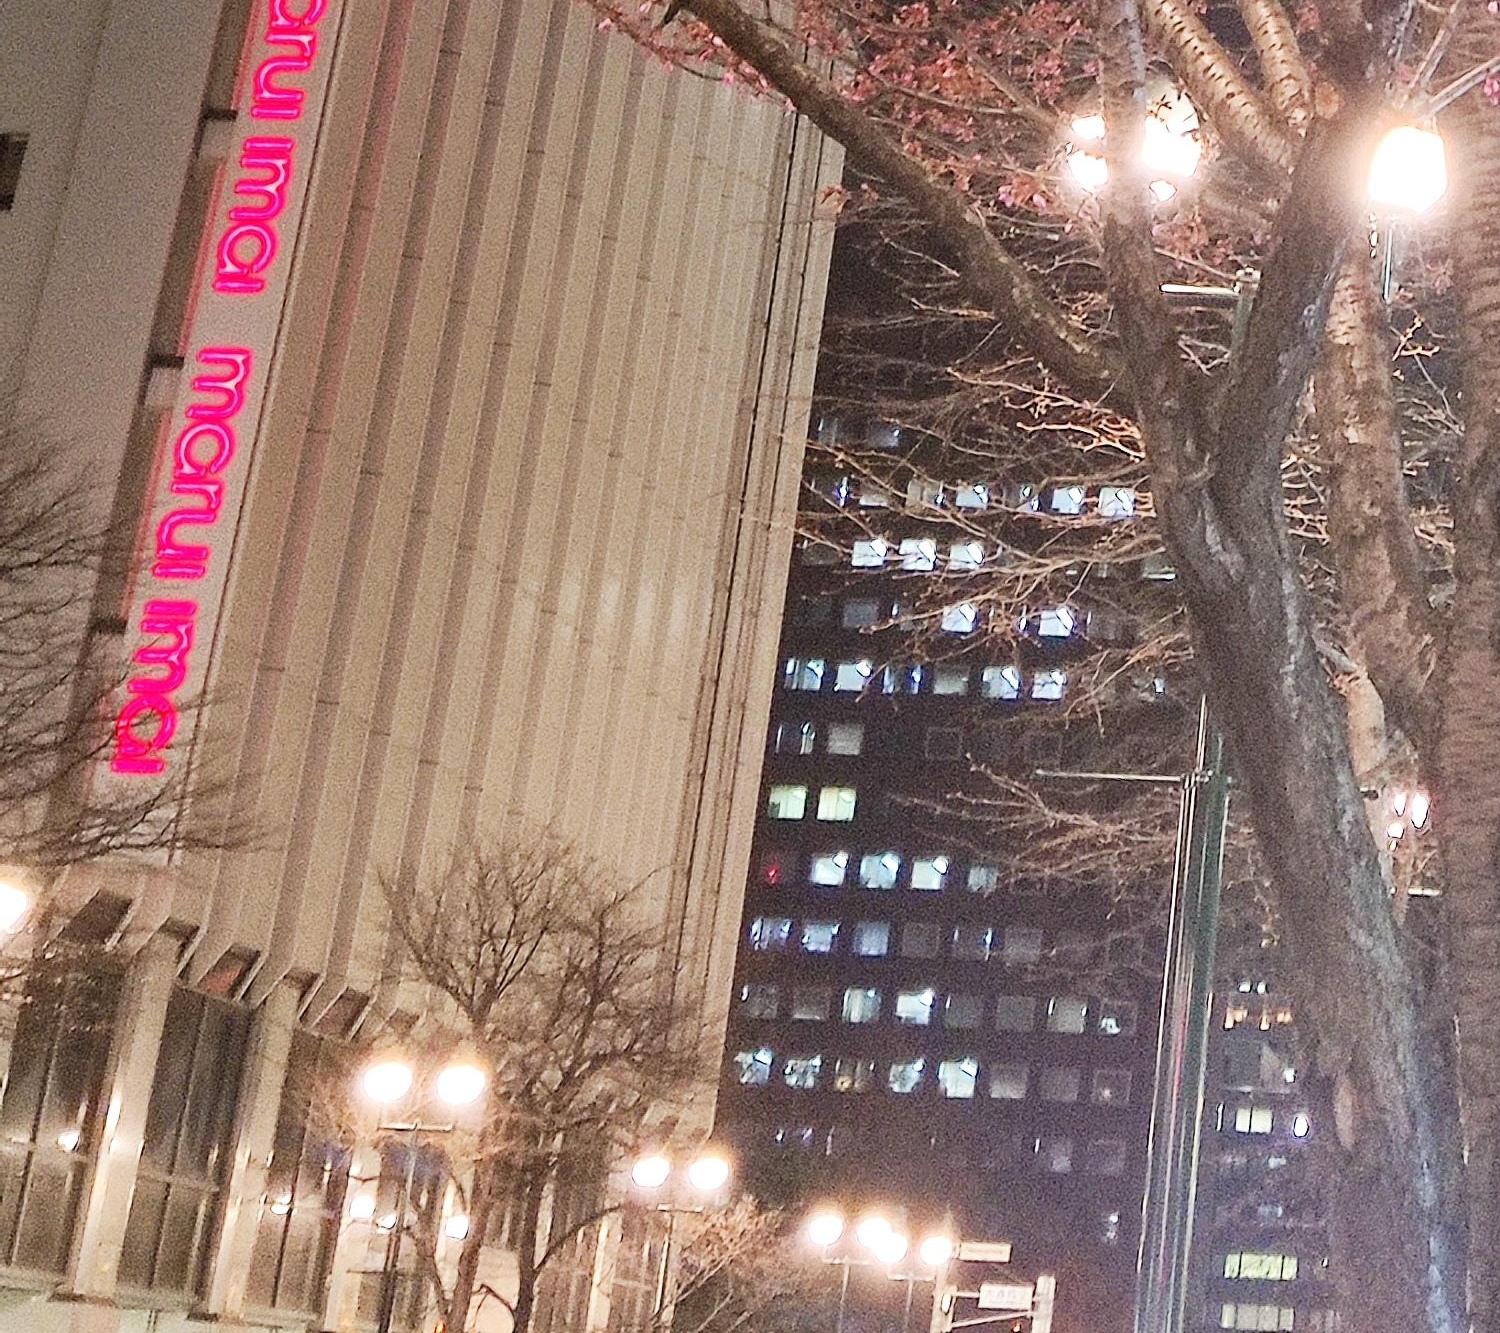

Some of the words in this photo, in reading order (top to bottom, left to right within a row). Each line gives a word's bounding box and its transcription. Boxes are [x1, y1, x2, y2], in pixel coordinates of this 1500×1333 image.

[213, 137, 295, 294] imai
[152, 348, 252, 580] marui
[111, 600, 198, 774] imai
